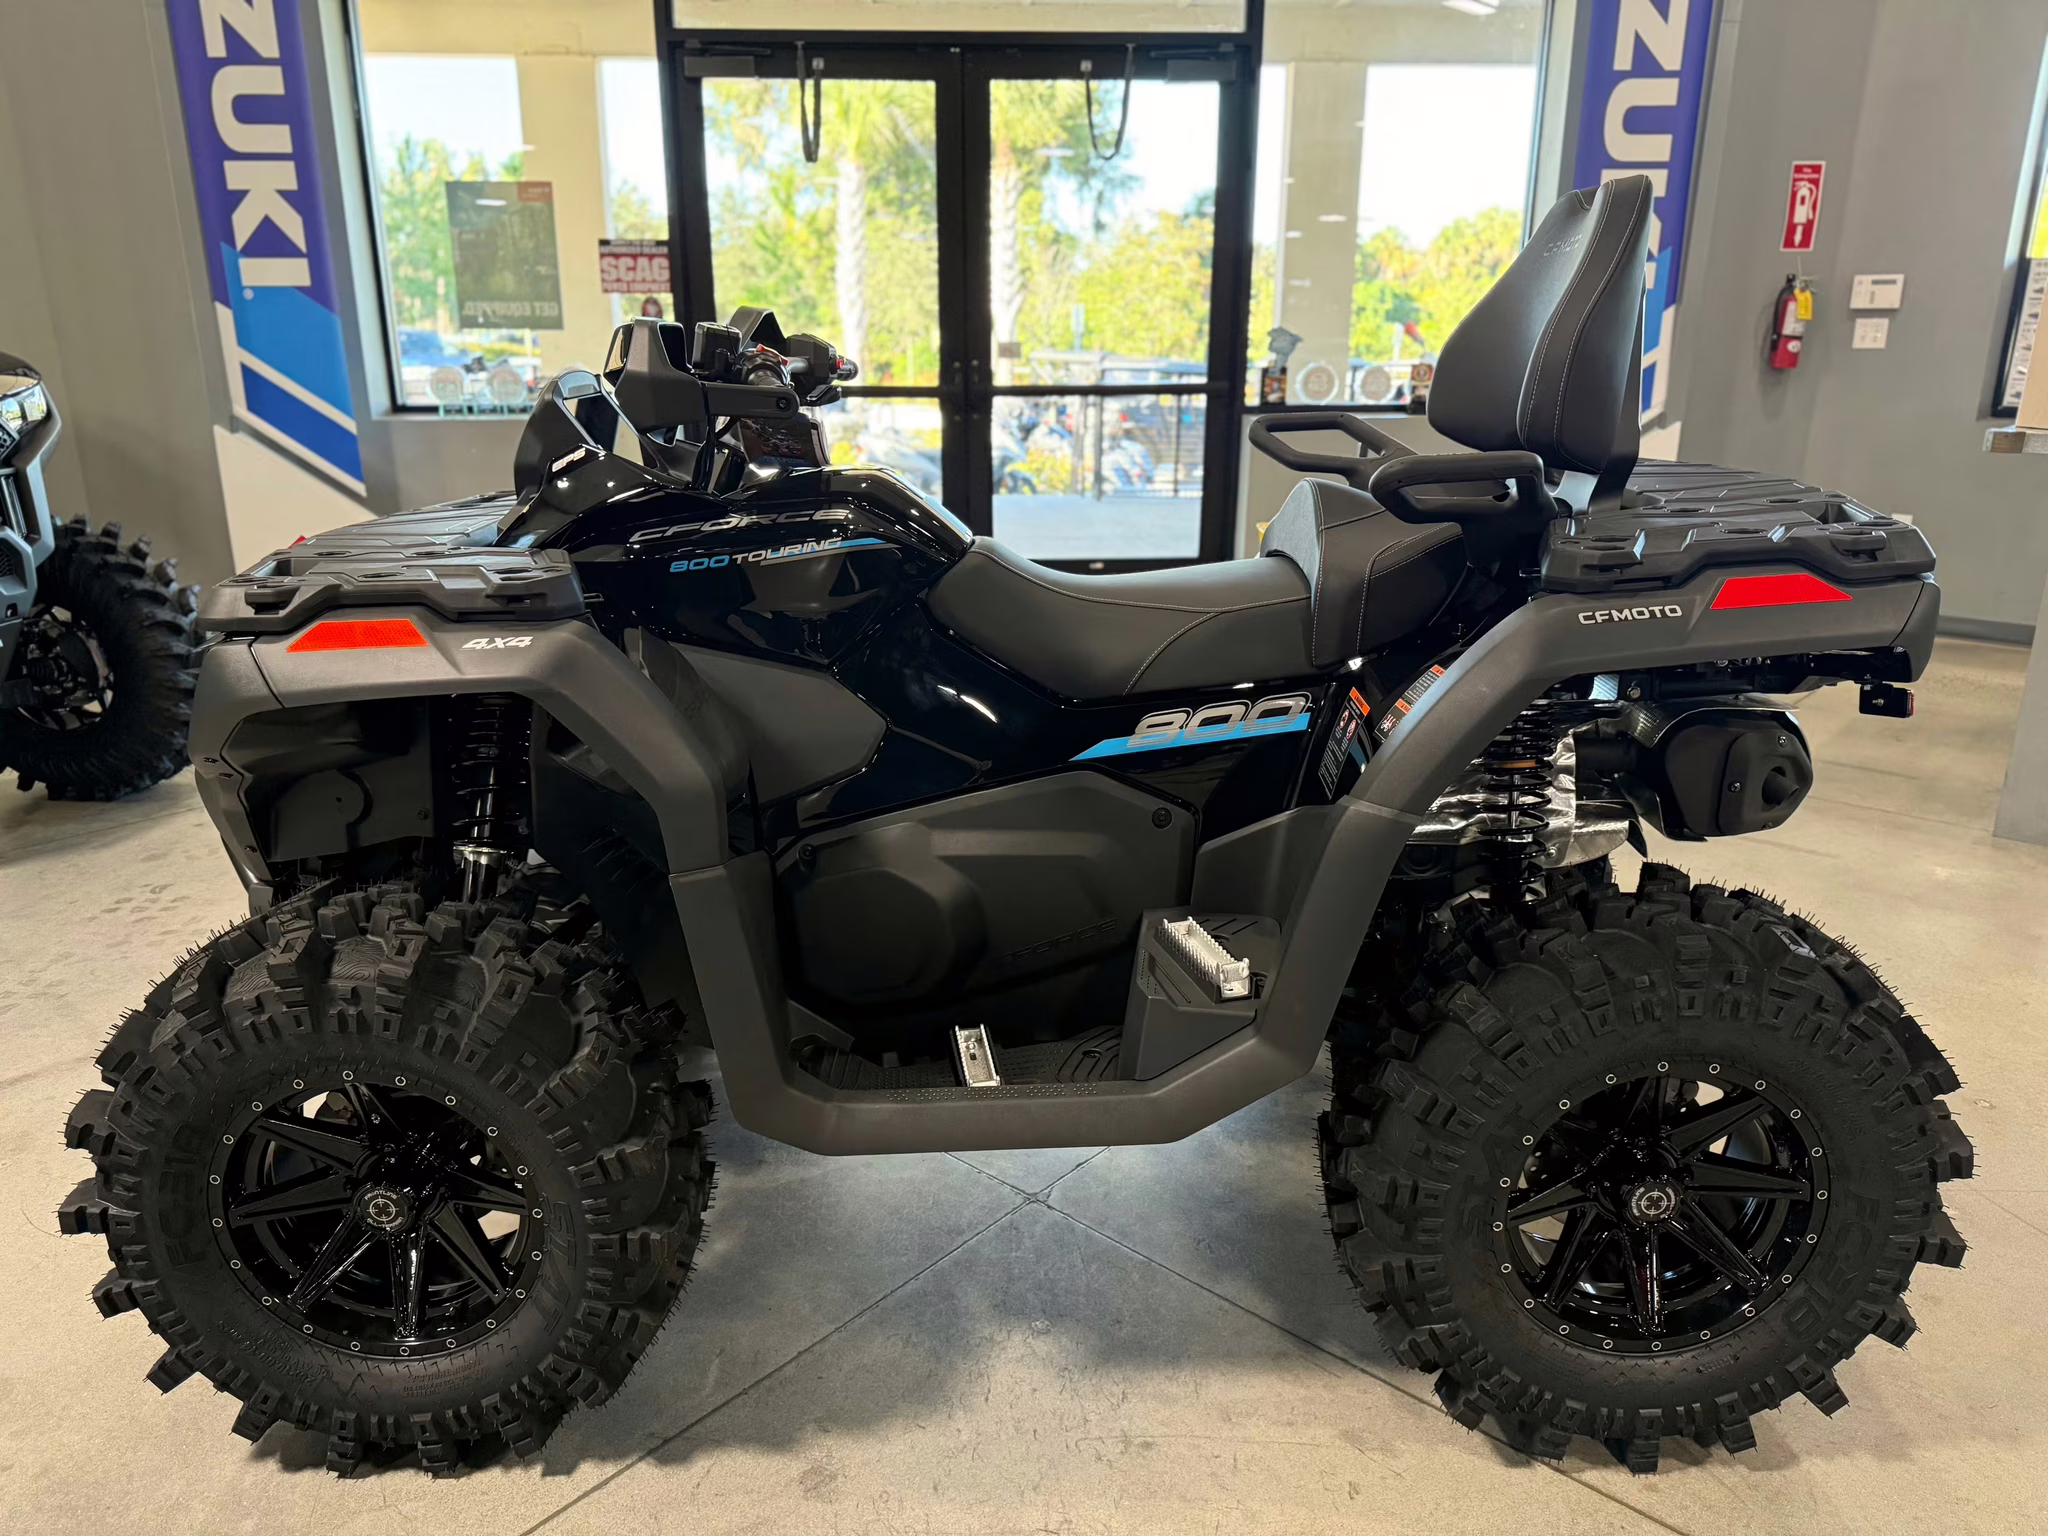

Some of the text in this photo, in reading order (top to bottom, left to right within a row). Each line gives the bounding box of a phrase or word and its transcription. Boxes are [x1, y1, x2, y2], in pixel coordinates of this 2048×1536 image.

[601, 256, 670, 281] SCAG
[629, 509, 850, 543] CFORCE
[669, 537, 843, 573] 800 TOURING
[1578, 605, 1682, 625] CFMOTO
[1127, 691, 1312, 749] 800
